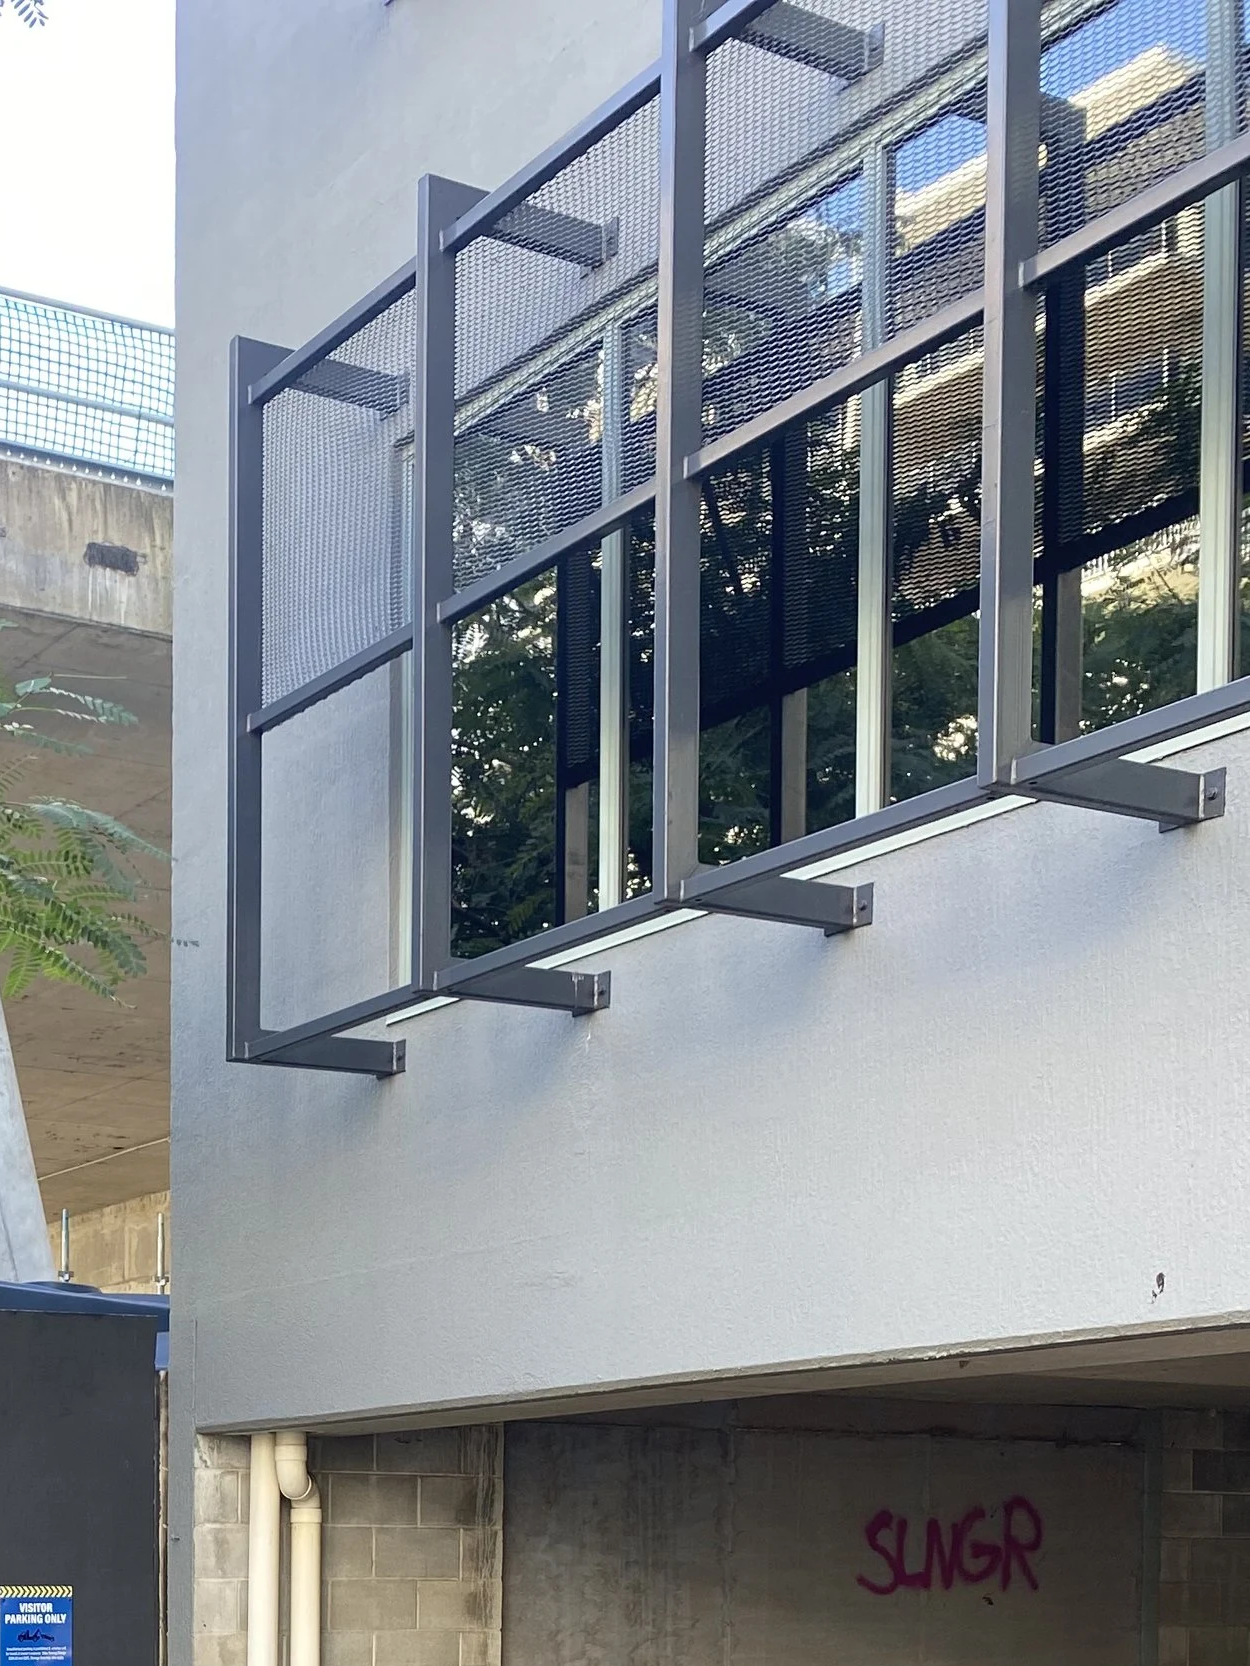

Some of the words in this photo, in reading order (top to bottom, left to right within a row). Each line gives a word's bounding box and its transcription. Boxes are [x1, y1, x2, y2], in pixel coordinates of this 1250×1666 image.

[19, 1602, 53, 1613] VISITOR
[4, 1614, 43, 1624] PARKING
[44, 1613, 67, 1624] ONLY
